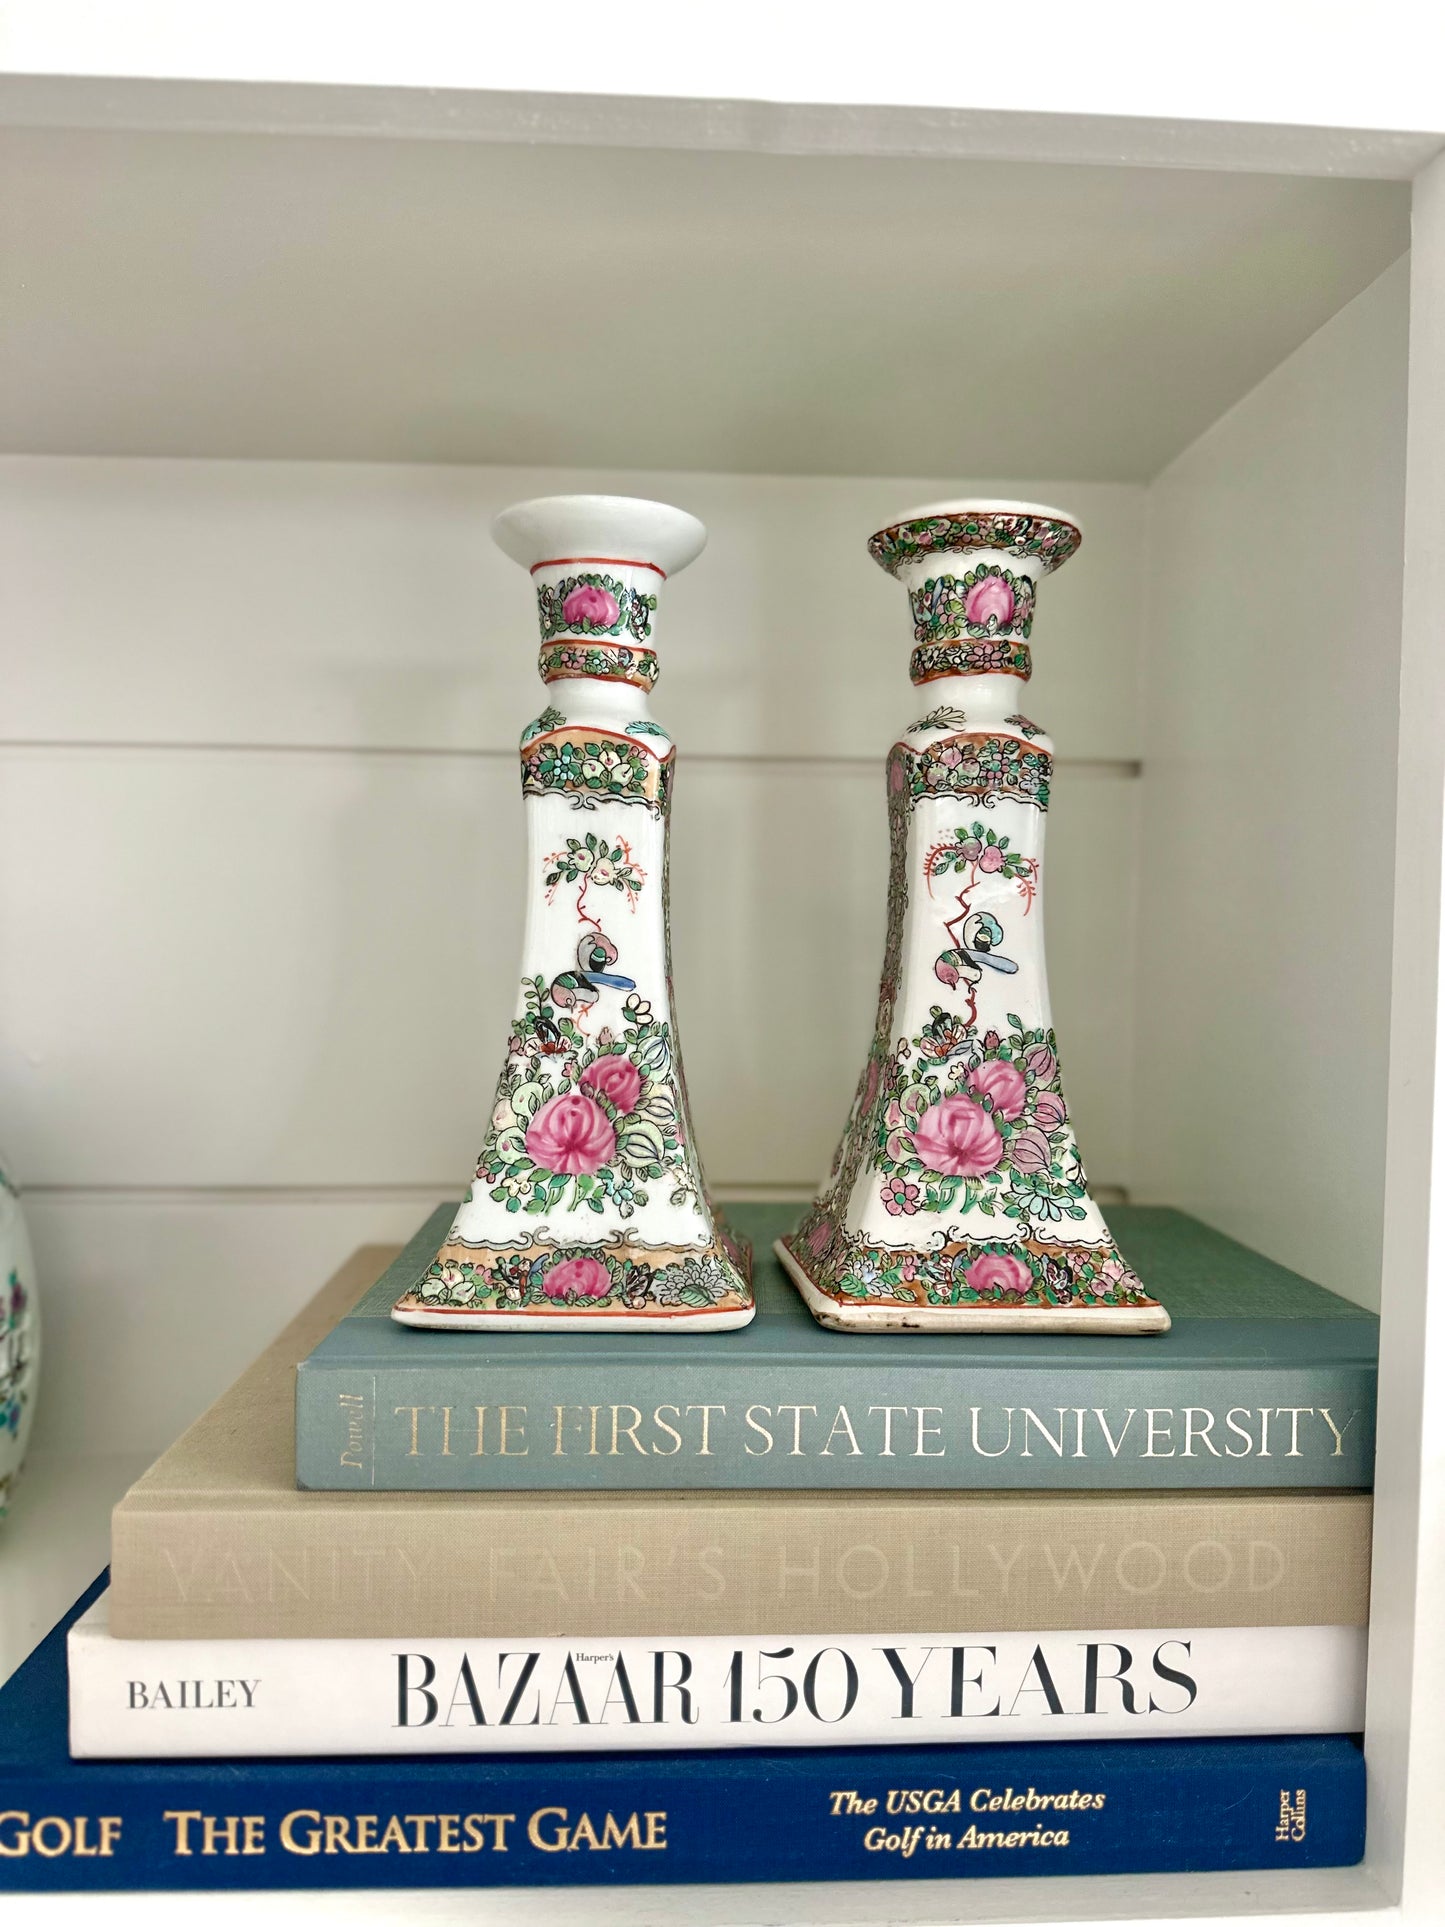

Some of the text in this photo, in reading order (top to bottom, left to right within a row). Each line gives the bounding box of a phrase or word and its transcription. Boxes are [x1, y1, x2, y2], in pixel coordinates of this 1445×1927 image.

[394, 1404, 1359, 1458] THE FIRST STATE UNIVERSITY
[164, 1546, 432, 1602] VANITY
[778, 1540, 1286, 1600] HOLLYWOOD
[127, 1680, 262, 1709] BAILEY
[391, 1640, 1198, 1728] BAZAAR 150 YEARS
[829, 1787, 1106, 1816] The USGA Celebrates
[1275, 1788, 1291, 1841] Harper
[1291, 1788, 1307, 1841] Collins
[0, 1810, 122, 1857] GOLF
[164, 1807, 668, 1855] THE GREATEST GAME
[863, 1824, 1071, 1858] Golf in America
